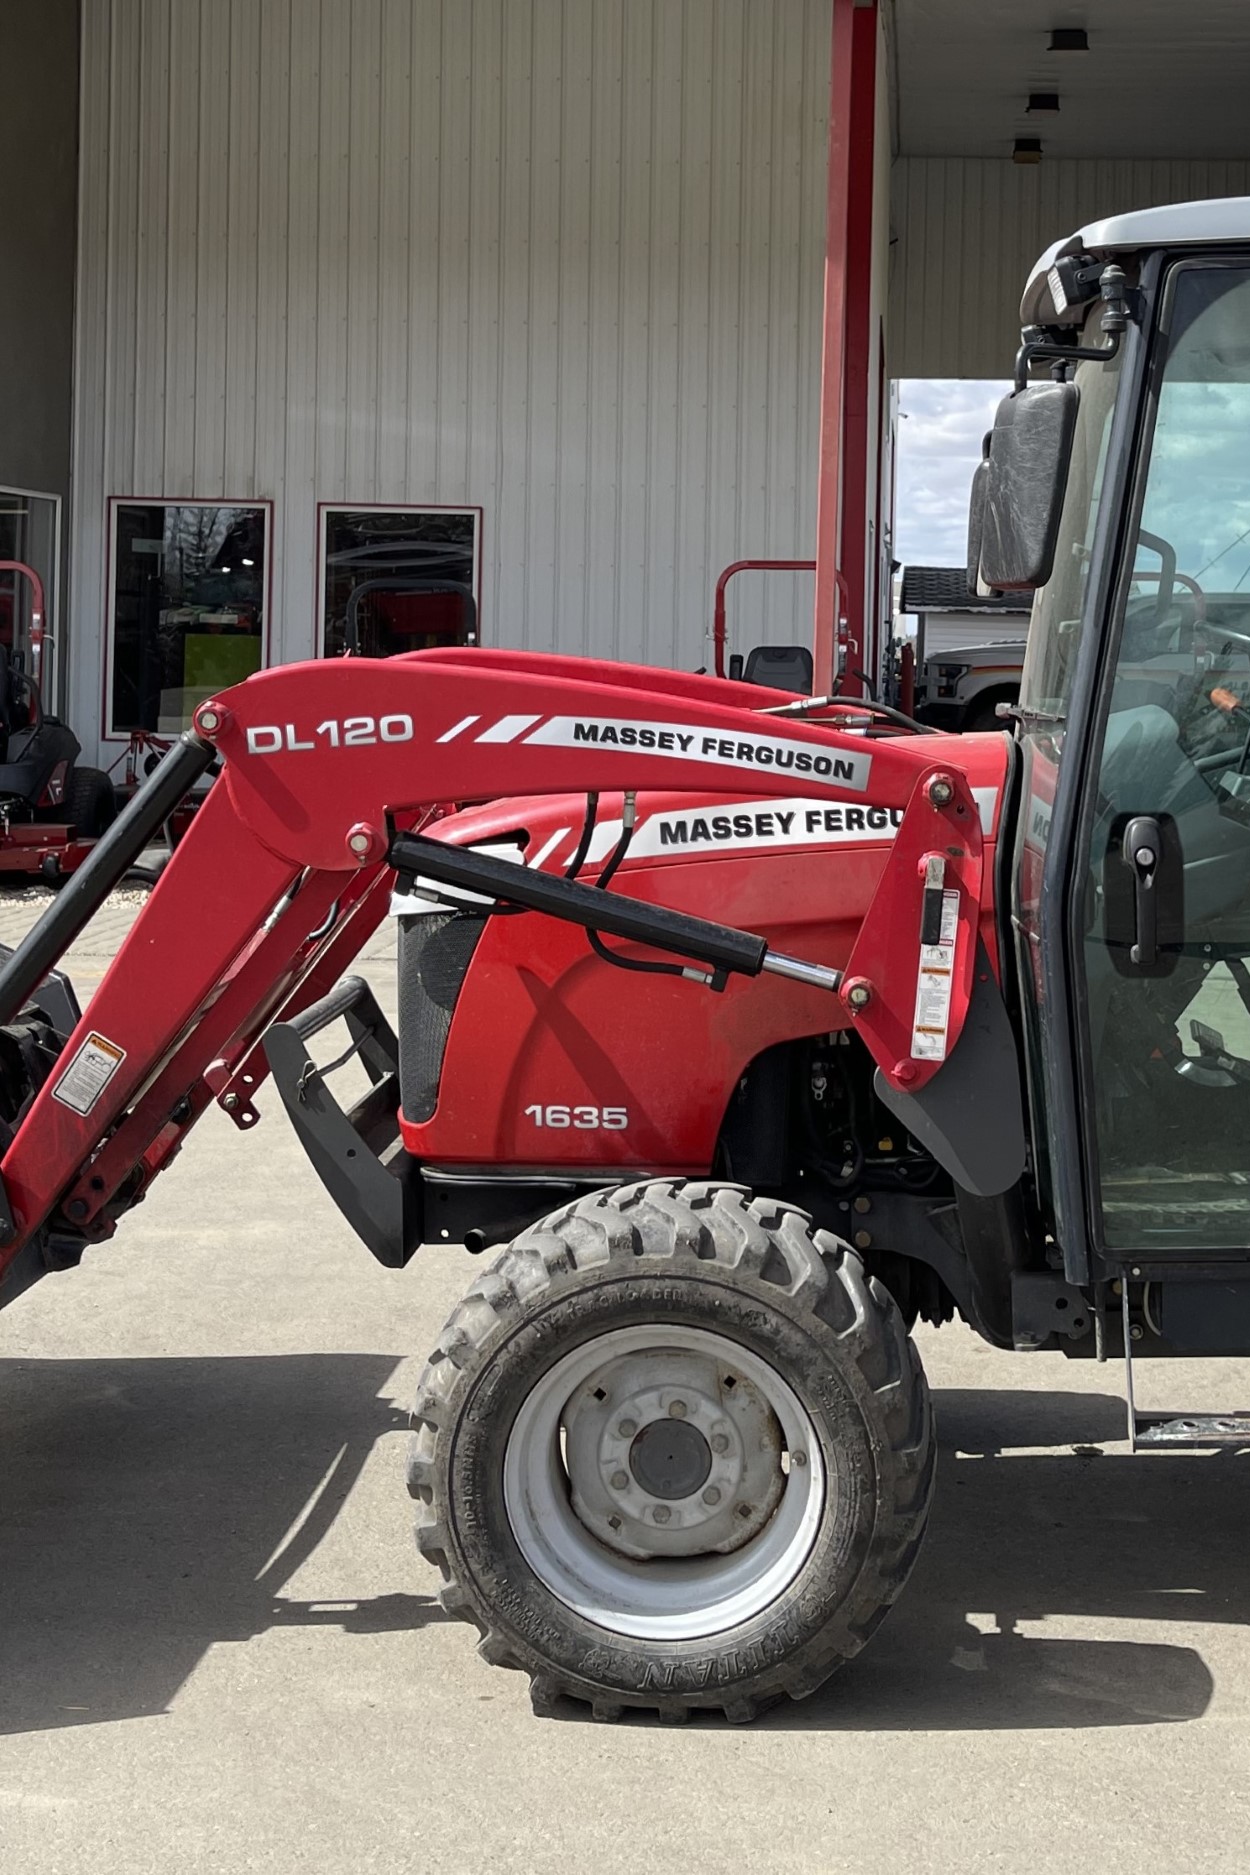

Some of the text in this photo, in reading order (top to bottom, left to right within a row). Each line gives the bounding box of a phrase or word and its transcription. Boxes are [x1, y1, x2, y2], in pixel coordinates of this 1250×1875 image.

[245, 714, 414, 754] DL120
[573, 723, 855, 780] MASSEY FERGUSON
[659, 807, 903, 844] MASSEY FERGU
[524, 1105, 628, 1130] 1635
[636, 1619, 799, 1690] TITAN
